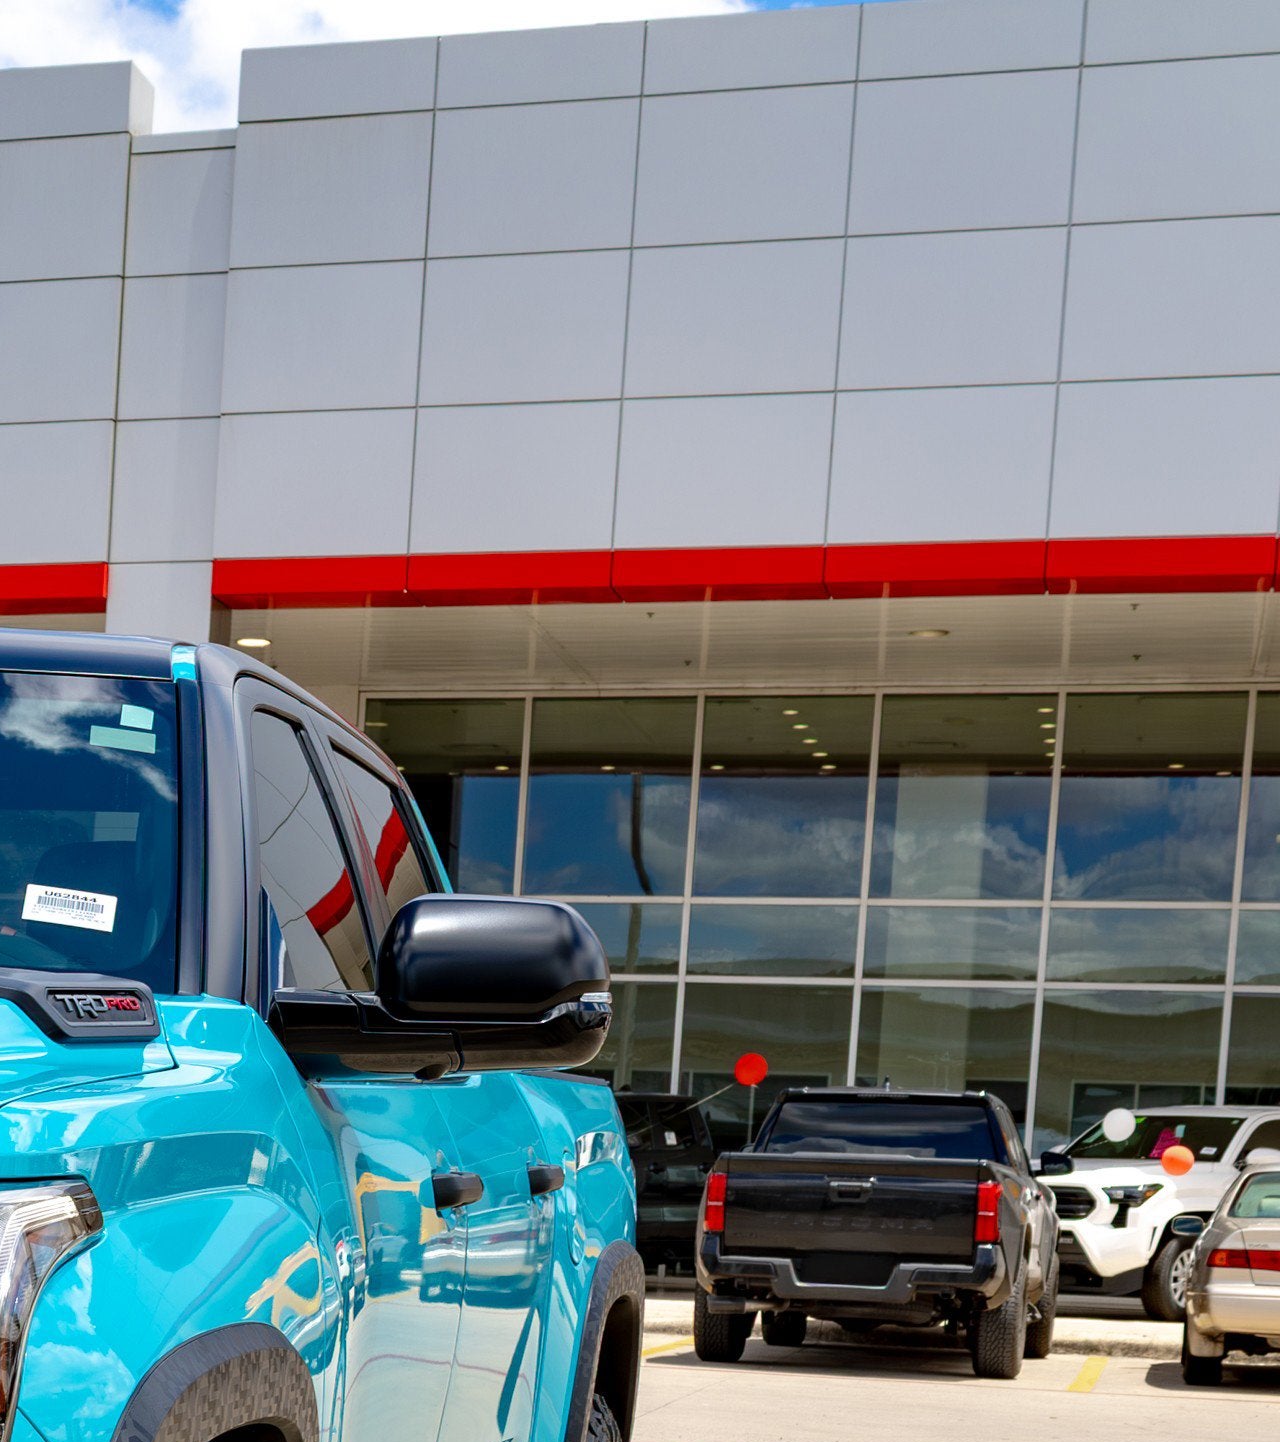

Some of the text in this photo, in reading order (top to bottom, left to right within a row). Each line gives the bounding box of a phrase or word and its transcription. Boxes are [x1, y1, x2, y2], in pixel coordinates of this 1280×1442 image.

[44, 890, 97, 903] U62844
[54, 994, 140, 1018] TRD PRO
